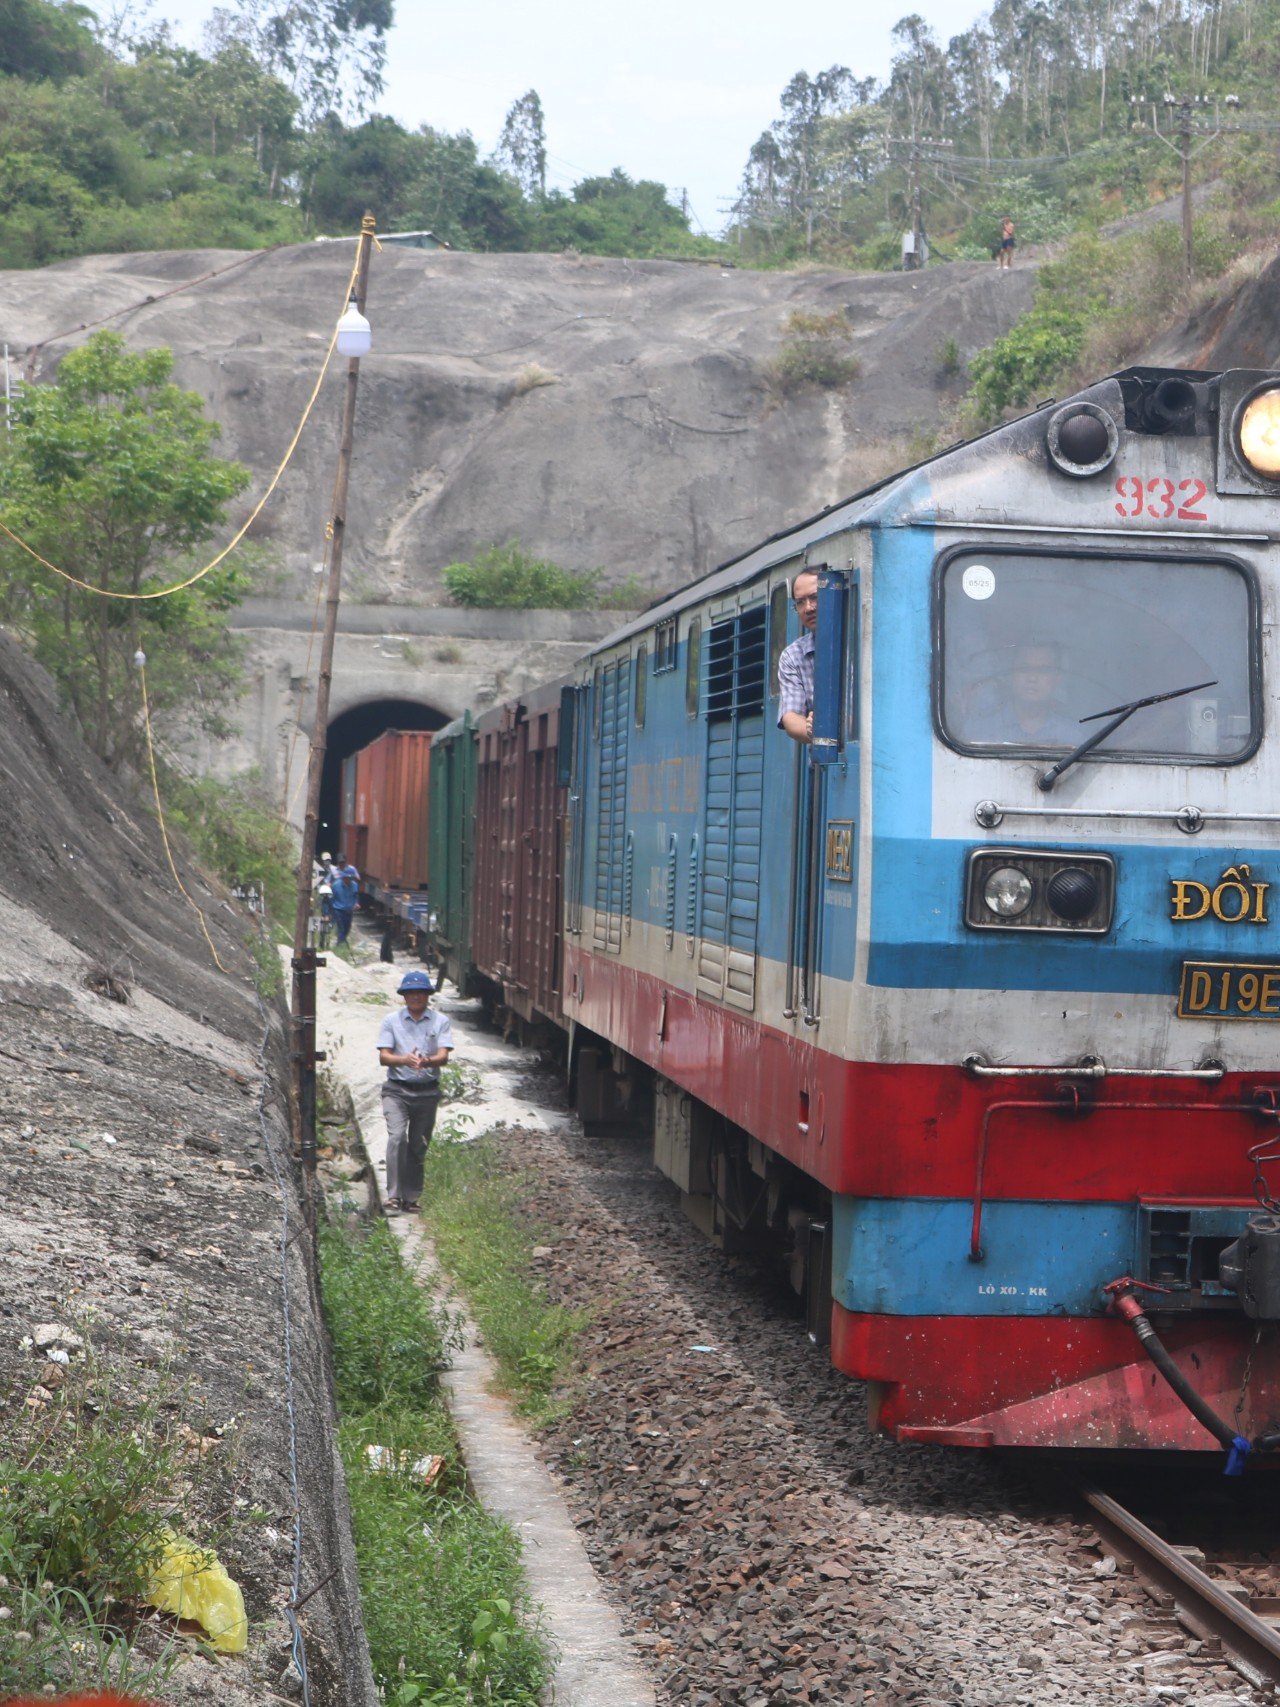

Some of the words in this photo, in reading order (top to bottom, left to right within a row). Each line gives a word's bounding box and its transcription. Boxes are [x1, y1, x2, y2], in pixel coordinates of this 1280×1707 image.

[1114, 475, 1208, 522] 932
[1171, 863, 1270, 923] ĐỔI
[999, 1286, 1018, 1296] XO
[1028, 1287, 1049, 1297] KK
